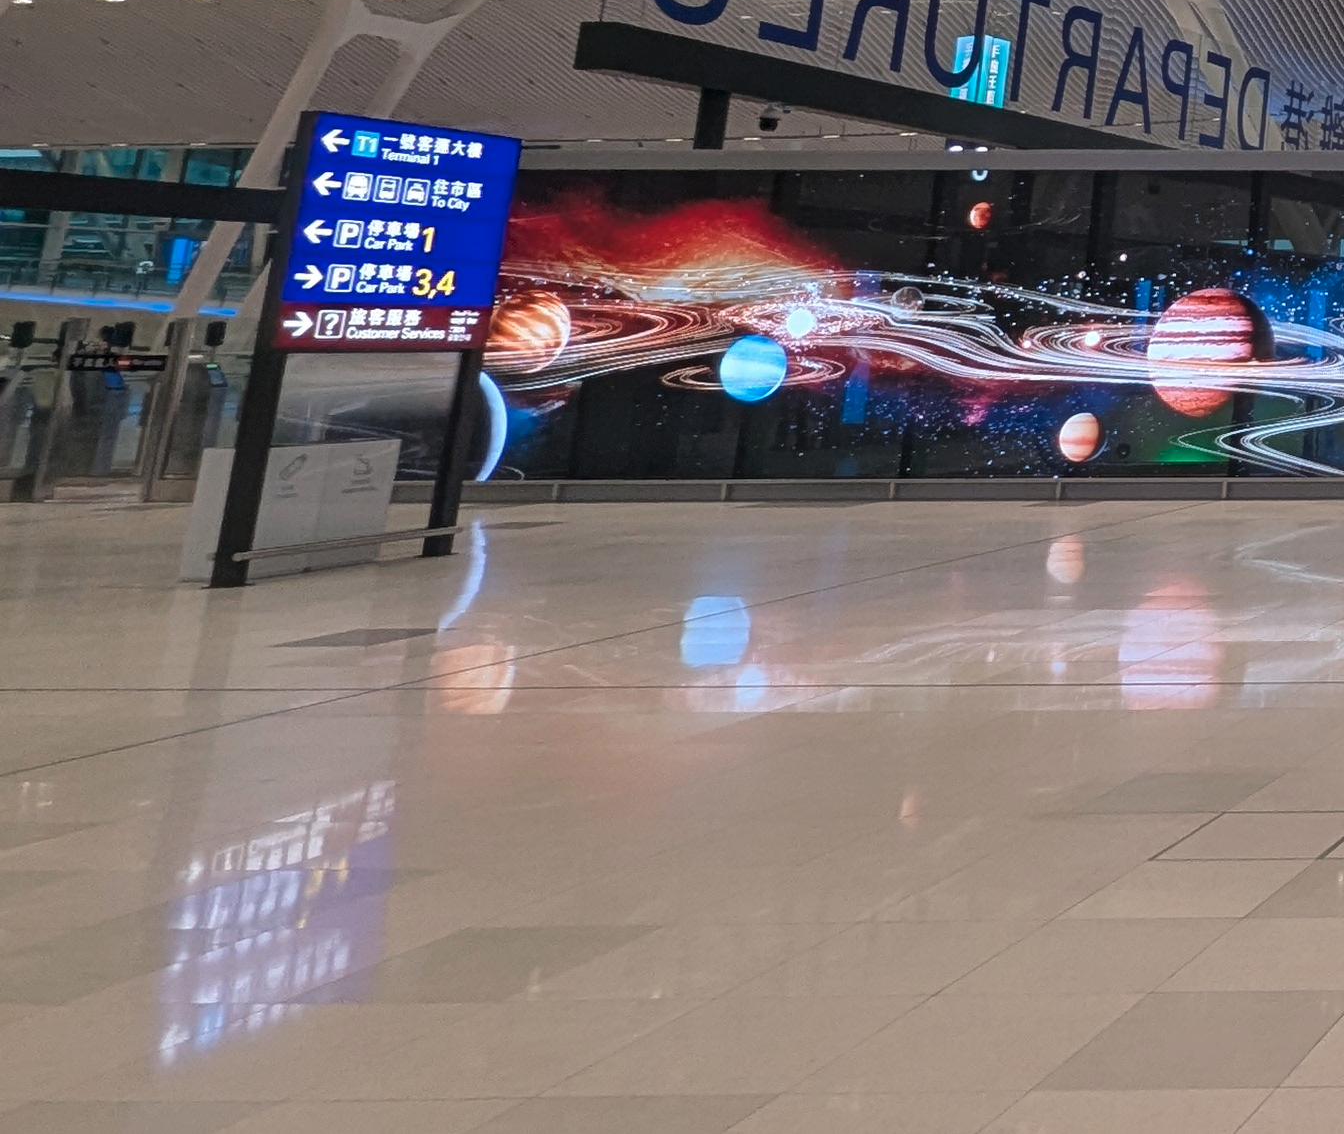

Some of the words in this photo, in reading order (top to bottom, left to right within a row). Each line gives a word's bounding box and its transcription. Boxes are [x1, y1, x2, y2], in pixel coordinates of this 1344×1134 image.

[355, 134, 379, 154] T1
[381, 147, 431, 165] Terminal
[433, 155, 440, 166] 1
[432, 178, 483, 198] 往市區
[431, 195, 446, 208] To
[447, 197, 470, 212] City
[367, 219, 421, 239] 停車場
[364, 237, 387, 250] Car
[386, 238, 414, 251] Park
[422, 226, 435, 253] 1
[359, 262, 413, 282] 停車場
[355, 281, 378, 294] Car
[378, 281, 406, 294] Park
[412, 268, 456, 300] 3,4
[348, 307, 422, 326] 旅客服務
[346, 326, 400, 339] Customer
[401, 327, 446, 340] Services
